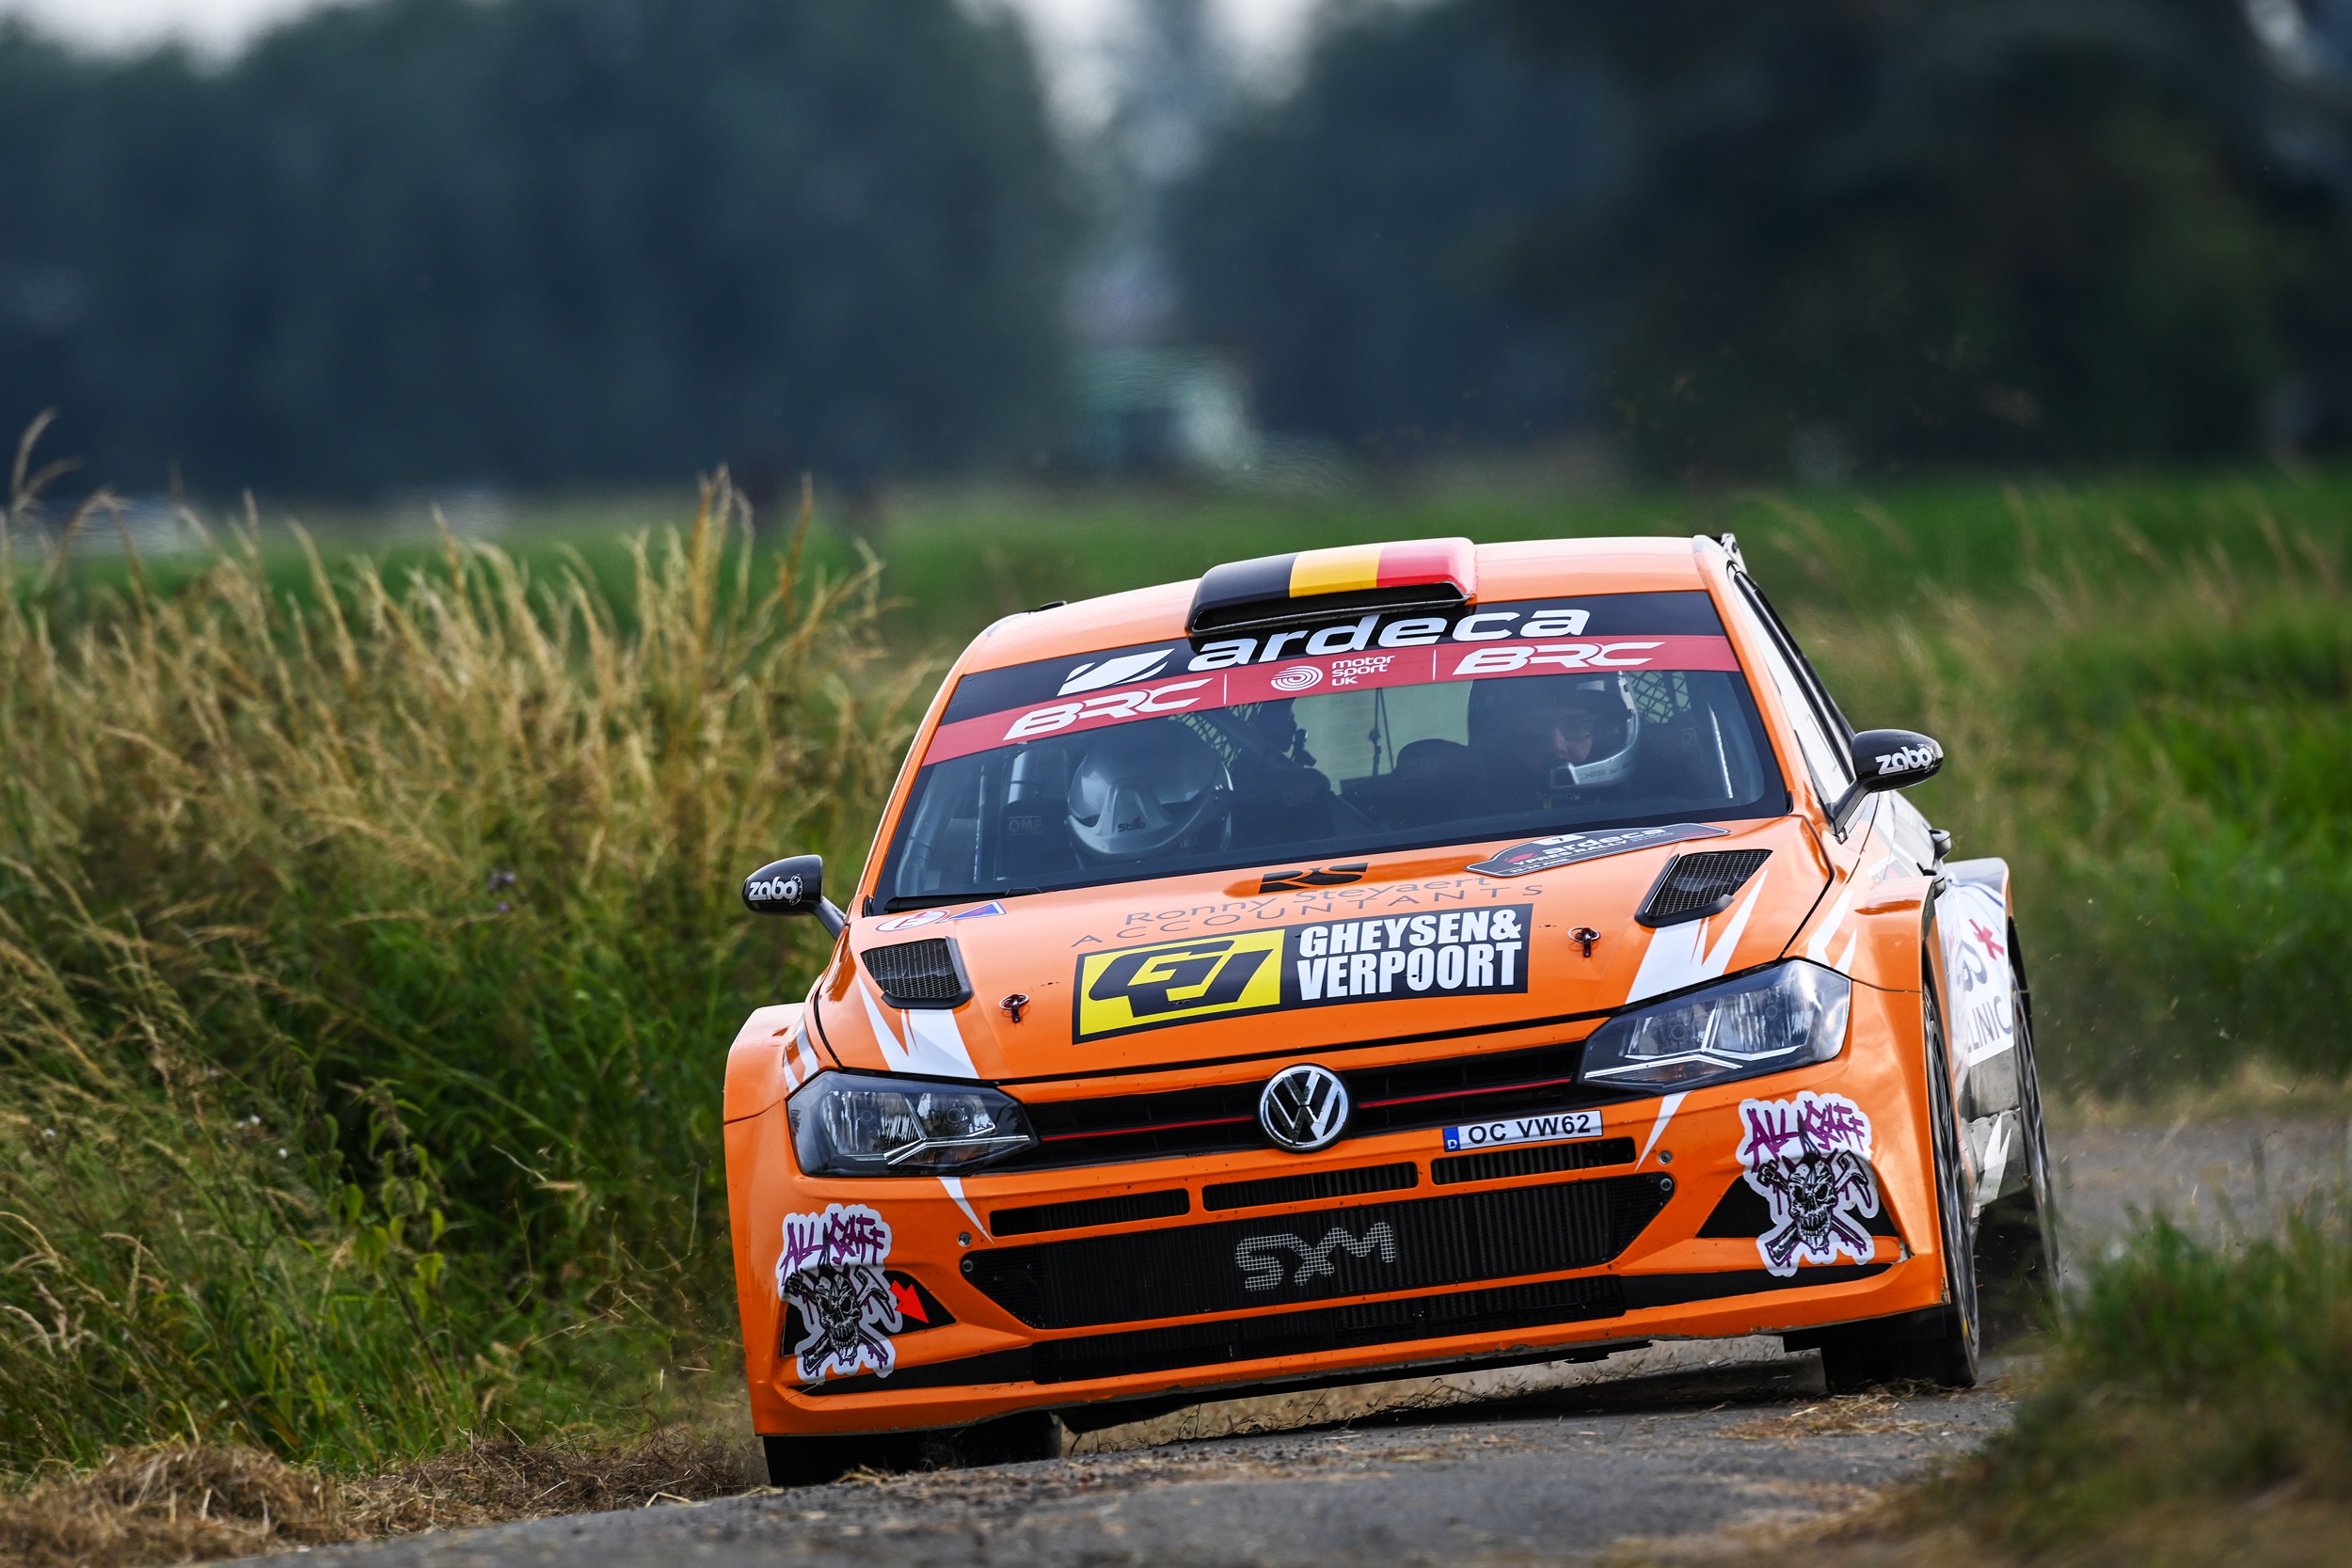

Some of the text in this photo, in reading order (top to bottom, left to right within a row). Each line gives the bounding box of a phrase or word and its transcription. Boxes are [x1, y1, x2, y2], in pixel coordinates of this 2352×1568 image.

[1187, 610, 1591, 672] ardeca
[1331, 655, 1396, 669] motor
[1331, 664, 1389, 677] sport
[1452, 641, 1665, 675] BRC
[1331, 676, 1359, 686] UK
[1003, 677, 1214, 741] BRC
[1009, 818, 1042, 832] OMP
[1512, 840, 1627, 865] YPRES RALLY
[1543, 829, 1666, 855] ardeca
[1259, 863, 1369, 894] RS
[1071, 884, 1544, 948] ACCOUNTANTS
[1125, 876, 1492, 927] Ronny Steyaert
[1298, 909, 1522, 958] GHEYSEN&
[1296, 942, 1522, 1001] VERPOORT
[1263, 1069, 1343, 1145] VW
[1447, 1139, 1458, 1149] D
[1468, 1114, 1591, 1144] OC VW62
